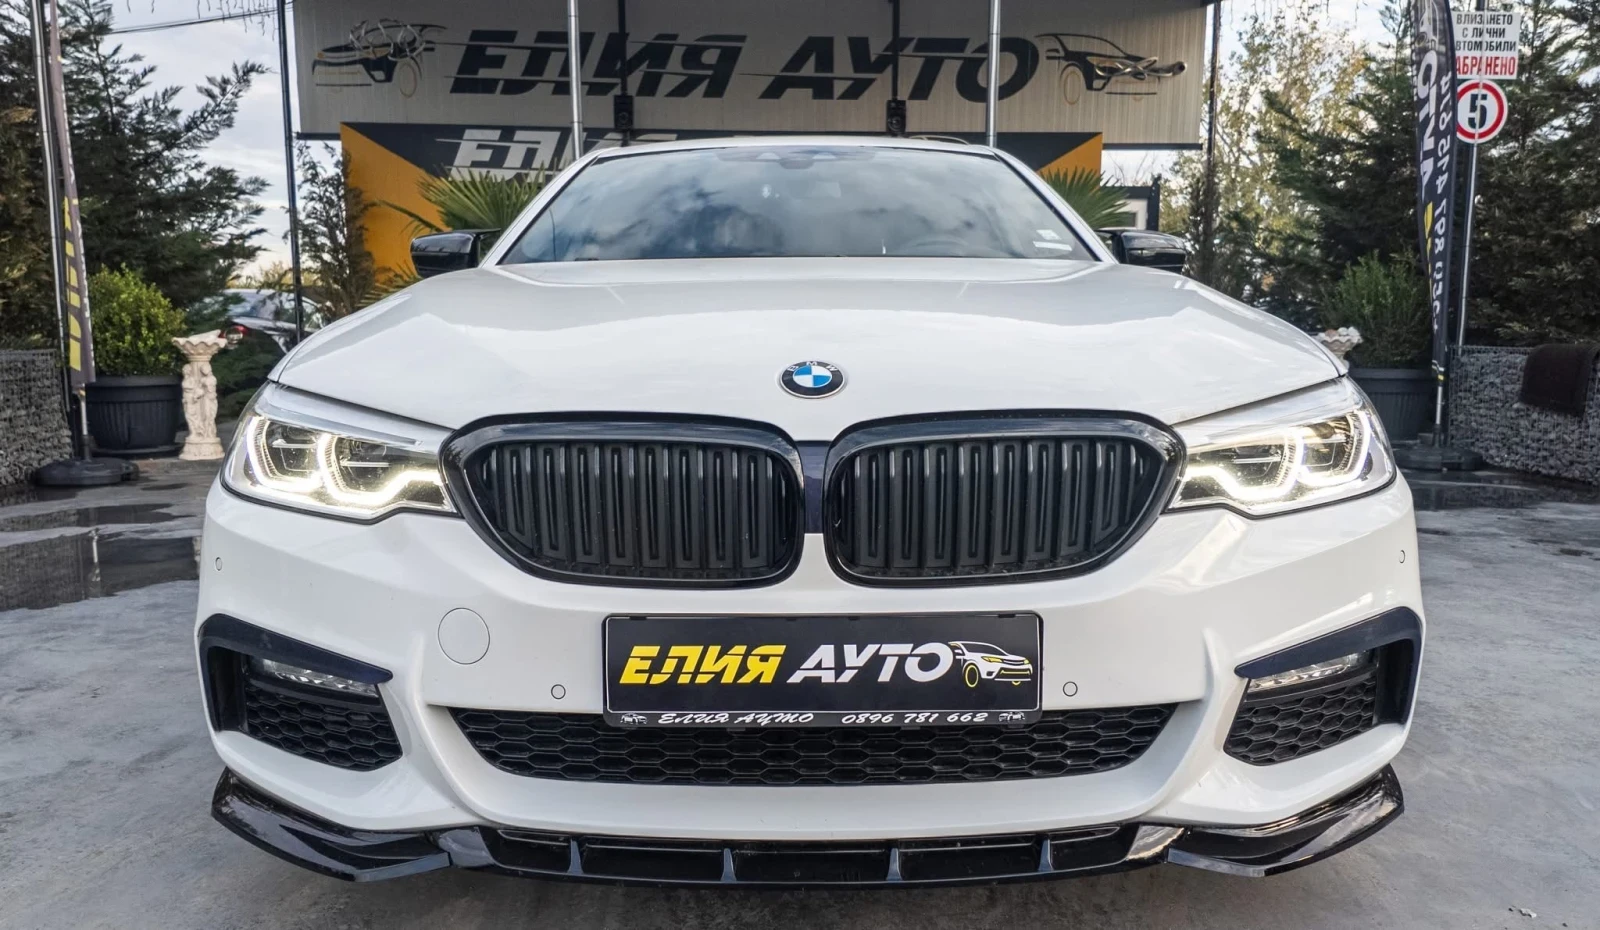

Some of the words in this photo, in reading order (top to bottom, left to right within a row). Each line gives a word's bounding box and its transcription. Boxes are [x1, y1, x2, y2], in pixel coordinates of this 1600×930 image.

[1471, 27, 1506, 38] ЛИЧНИ
[1455, 40, 1517, 52] ВТОМБИЛИ
[449, 29, 748, 99] ЕЛИЯ
[758, 35, 1040, 103] АУТО
[1455, 55, 1516, 76] АБРАНЕНО
[1467, 93, 1488, 129] 5
[786, 361, 839, 372] BMW
[619, 645, 787, 685] ЕЛИЯ
[787, 642, 954, 683] АУТО
[657, 713, 730, 724] ЕЛИЯ
[841, 713, 895, 724] 0896
[903, 712, 940, 724] 781
[946, 712, 989, 723] 662
